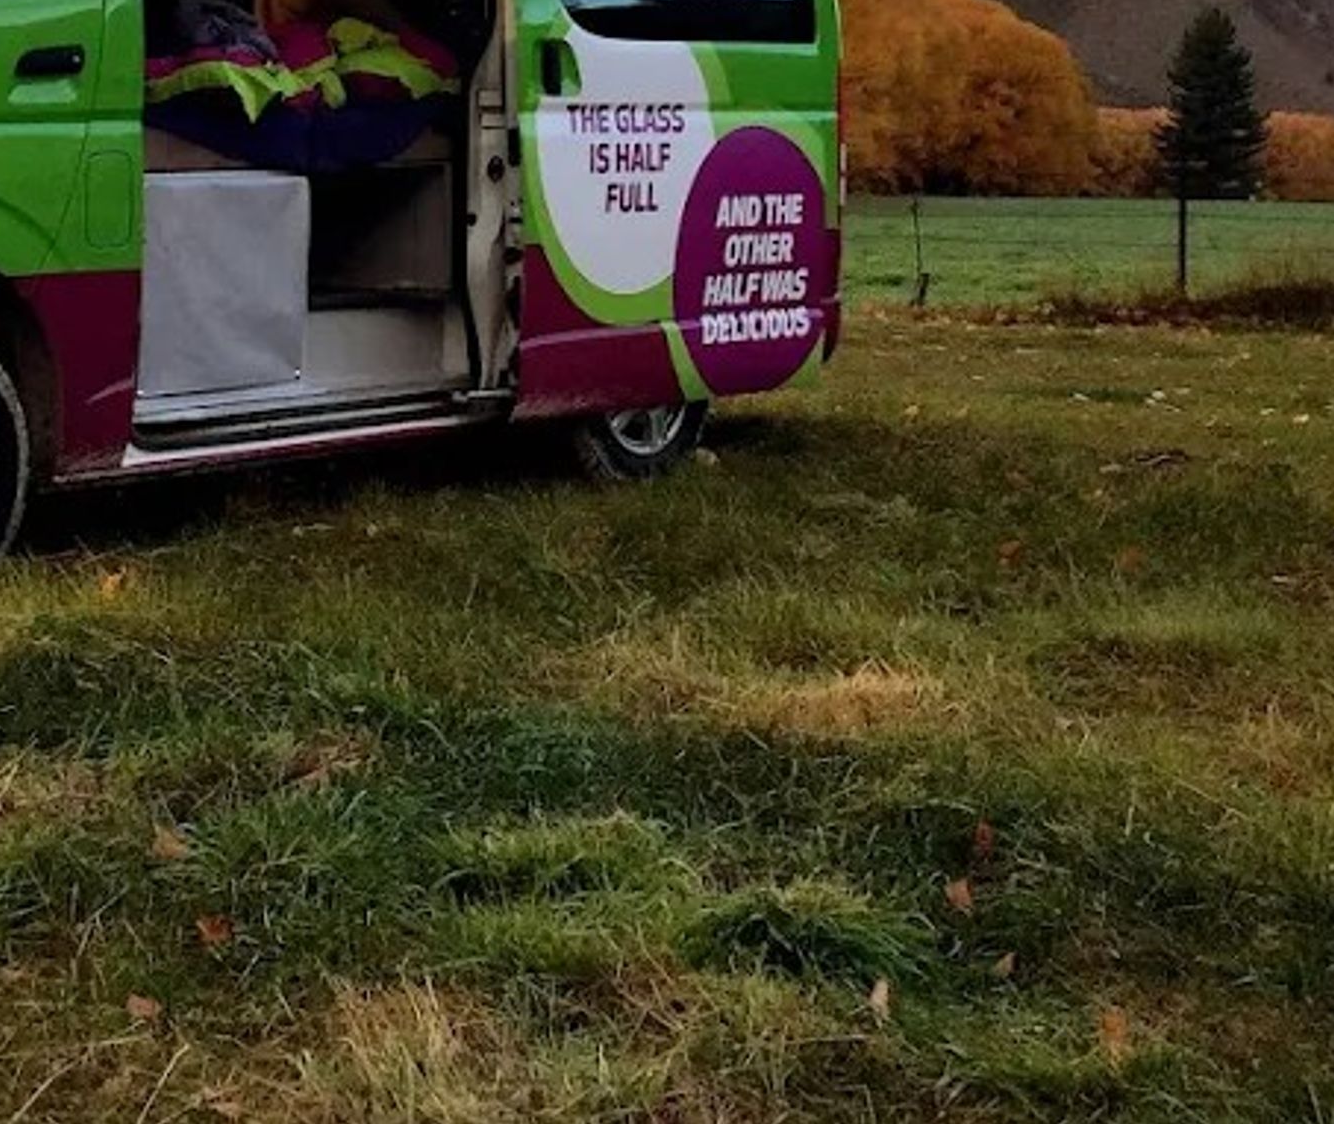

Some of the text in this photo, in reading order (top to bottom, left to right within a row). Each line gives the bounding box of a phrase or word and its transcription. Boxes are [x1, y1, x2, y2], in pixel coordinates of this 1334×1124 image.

[566, 103, 686, 134] THE GLASS
[589, 142, 671, 174] IS HALF
[604, 181, 659, 214] FULL
[716, 193, 805, 228] AND THE
[723, 231, 795, 268] OTHER
[702, 267, 810, 307] HALF WAS
[700, 305, 812, 346] DELICIOUS
